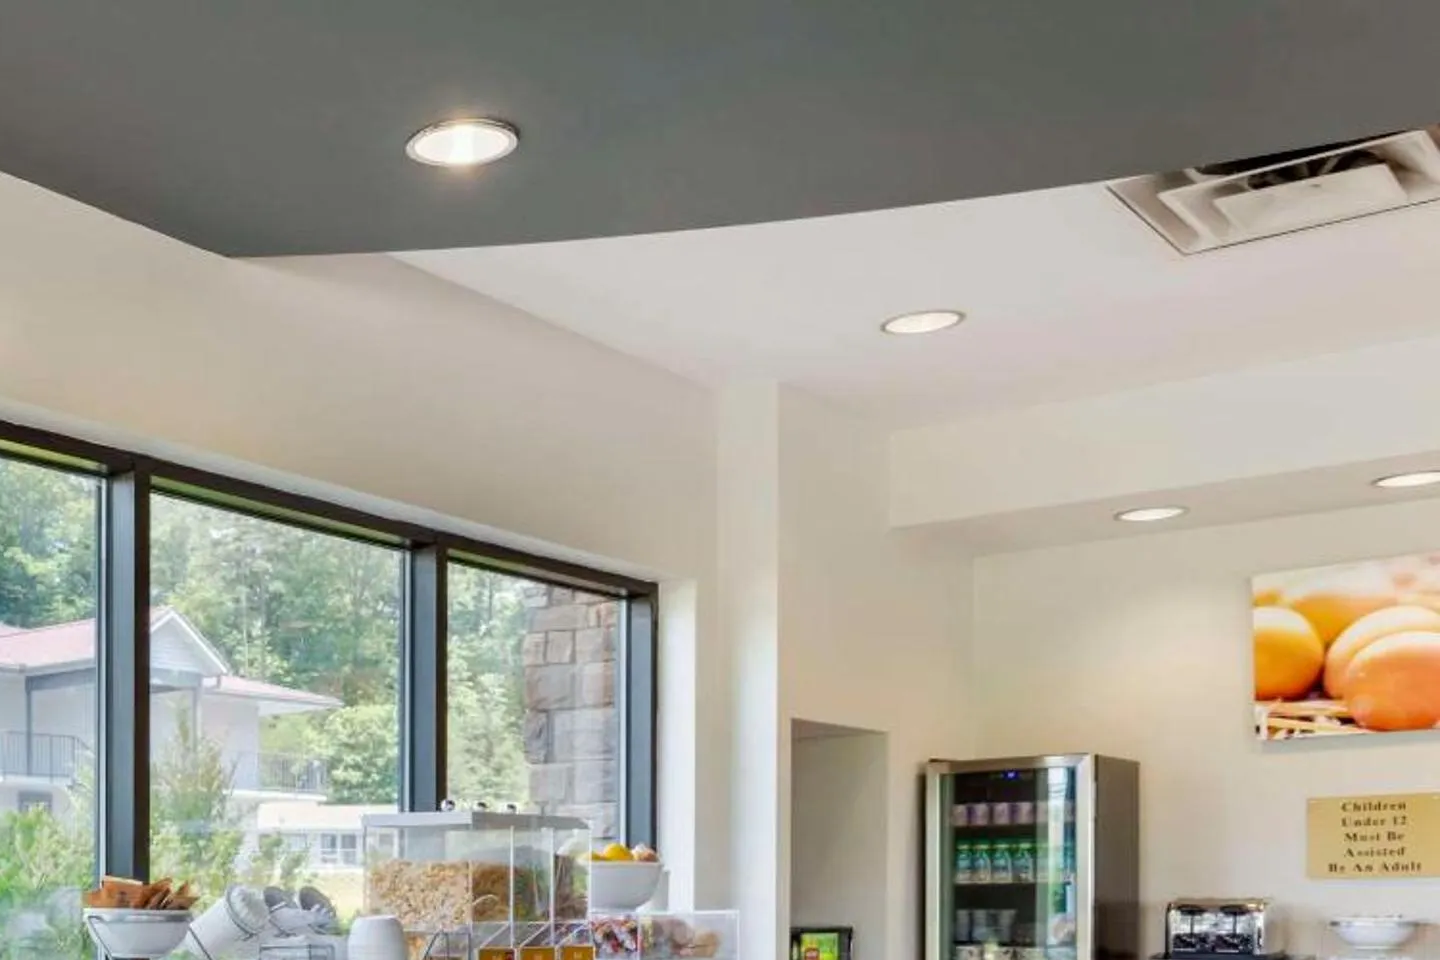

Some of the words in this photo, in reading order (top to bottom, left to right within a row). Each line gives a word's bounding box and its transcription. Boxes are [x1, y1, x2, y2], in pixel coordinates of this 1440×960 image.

[1341, 801, 1406, 812] Children
[1341, 817, 1386, 827] Under
[1392, 815, 1407, 825] 12
[1344, 832, 1380, 842] Must
[1387, 831, 1405, 841] Be
[1344, 847, 1406, 858] Assisted
[1353, 863, 1373, 873] An
[1382, 861, 1422, 872] Adult
